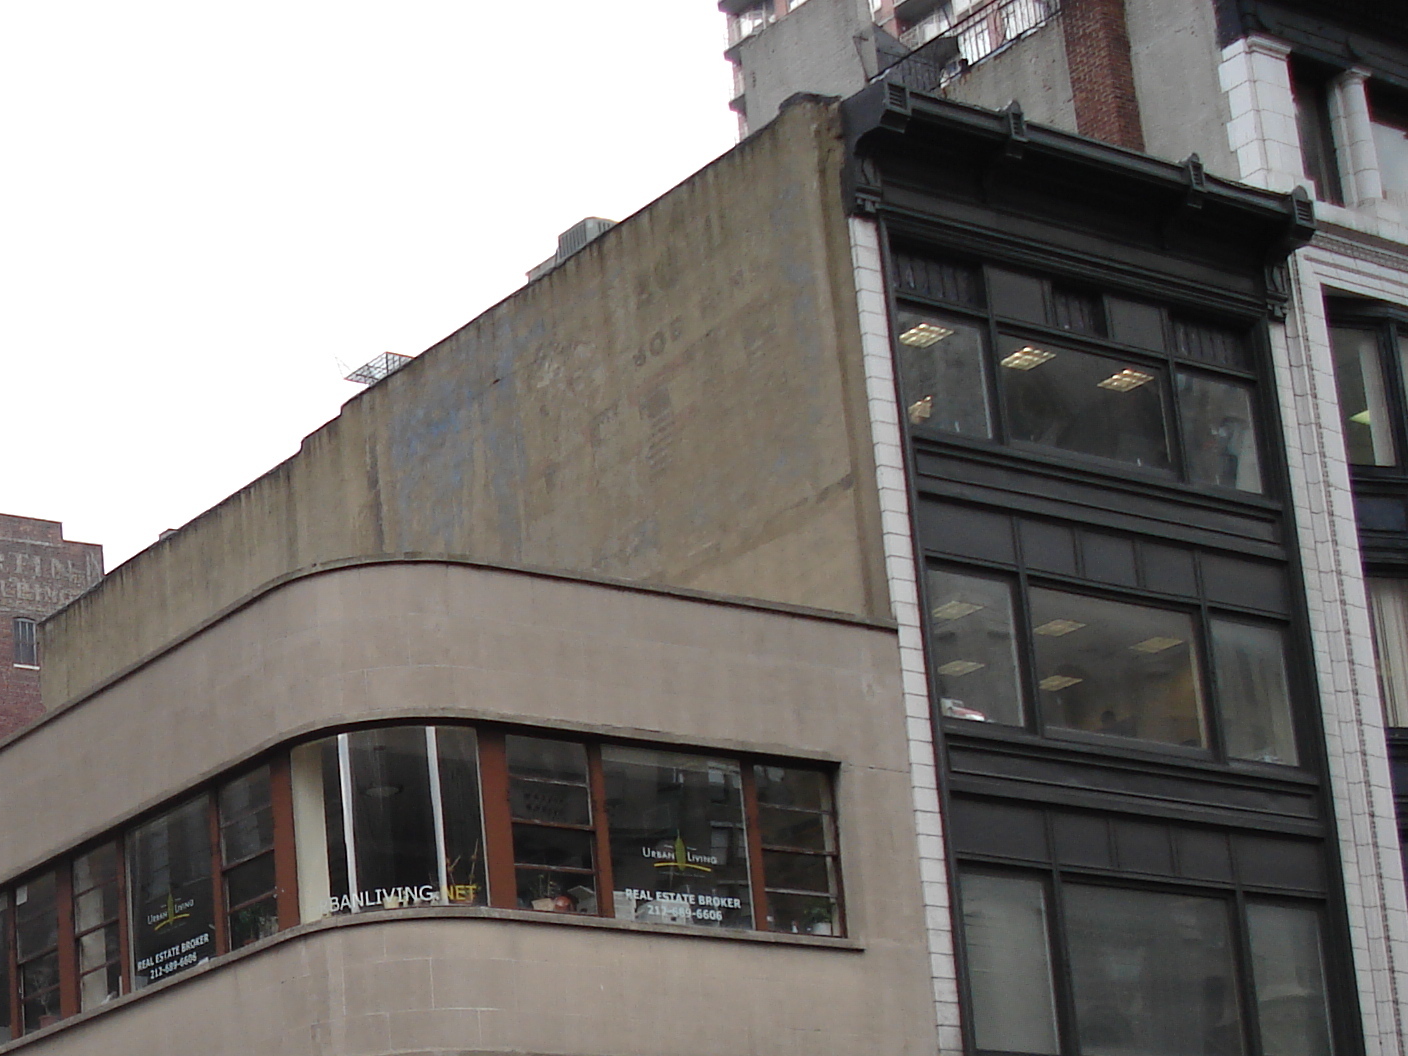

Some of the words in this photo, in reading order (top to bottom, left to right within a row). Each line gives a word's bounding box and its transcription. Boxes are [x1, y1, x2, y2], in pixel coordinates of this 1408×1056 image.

[625, 888, 653, 900] REAL
[656, 892, 696, 904] ESTATE
[698, 895, 741, 909] BROKER
[647, 905, 723, 920] 212-689-6606
[137, 956, 154, 971] REAL
[155, 945, 180, 963] ESTATE
[181, 933, 209, 953] BROKER
